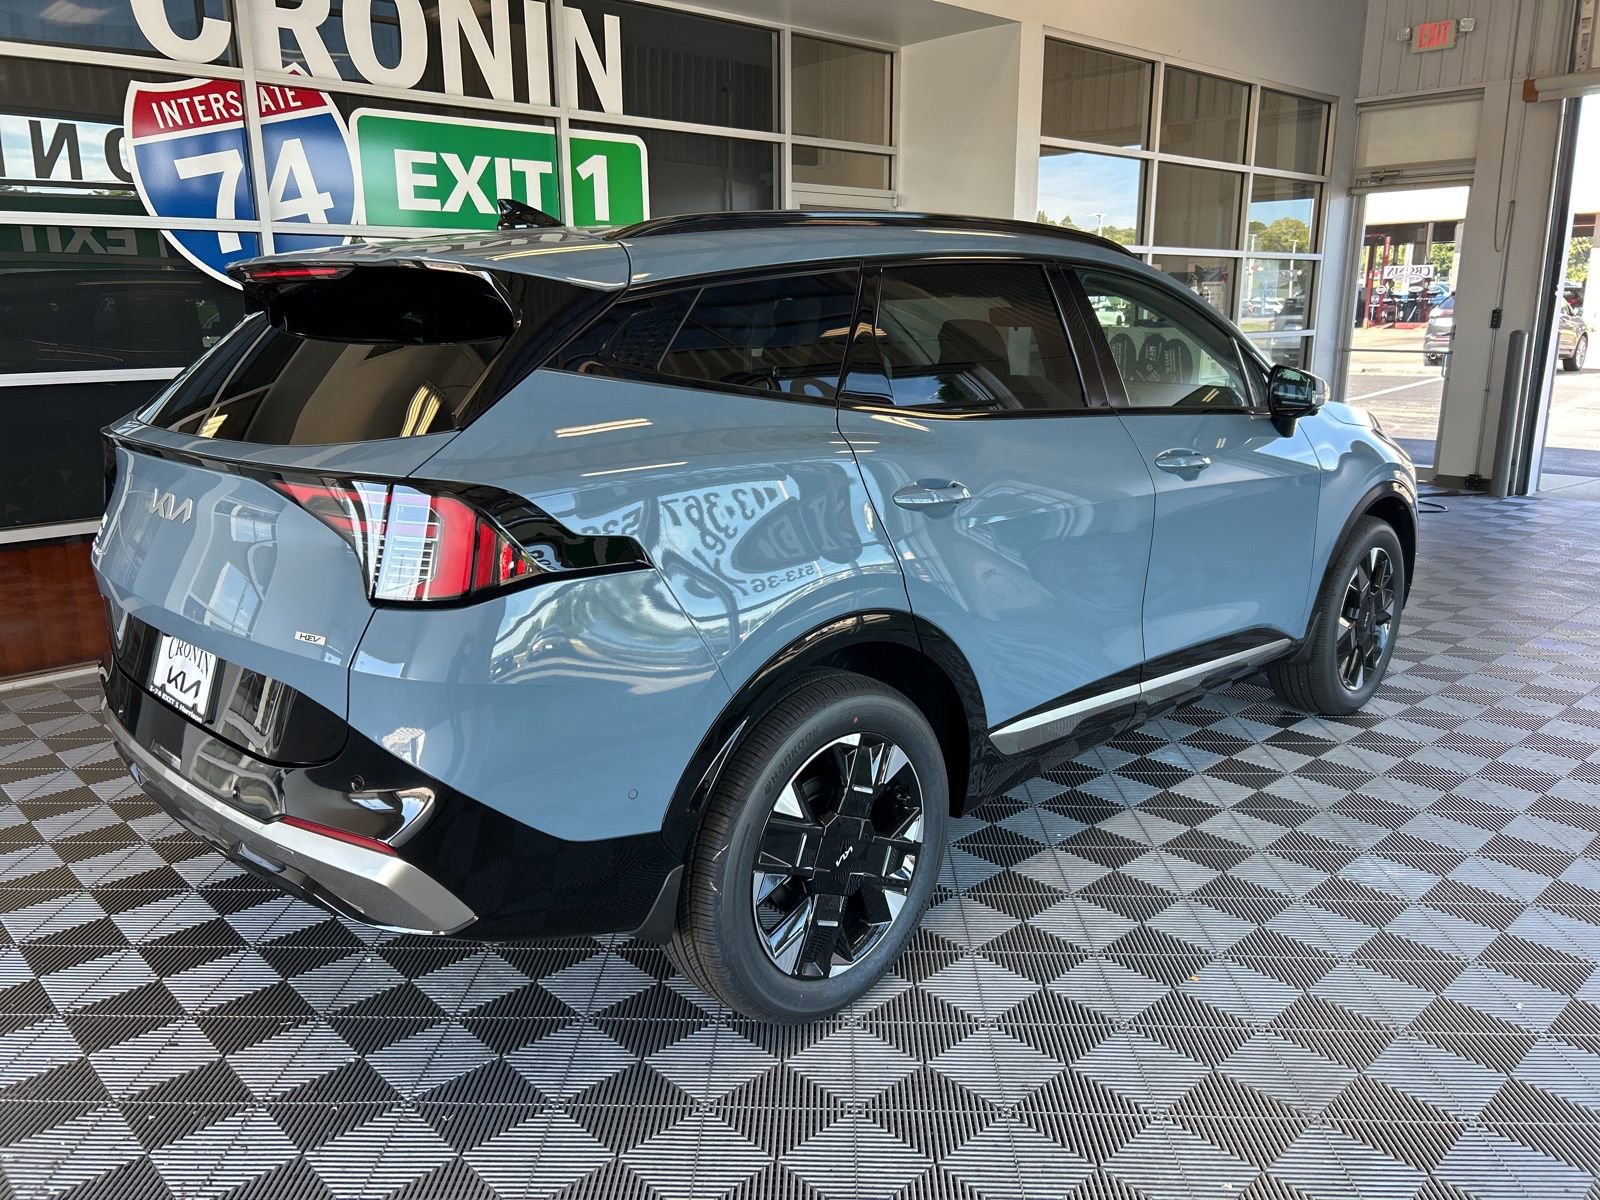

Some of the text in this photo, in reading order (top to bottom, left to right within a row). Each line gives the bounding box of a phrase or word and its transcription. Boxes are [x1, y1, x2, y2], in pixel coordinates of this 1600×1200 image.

[1418, 21, 1451, 48] EXIT
[130, 0, 623, 115] CRONIN
[151, 85, 303, 130] INTERSATE
[173, 137, 335, 254] 74
[394, 149, 610, 222] EXIT 1
[149, 487, 193, 525] KIA
[168, 636, 213, 679] CRONIN
[166, 665, 202, 699] KIA
